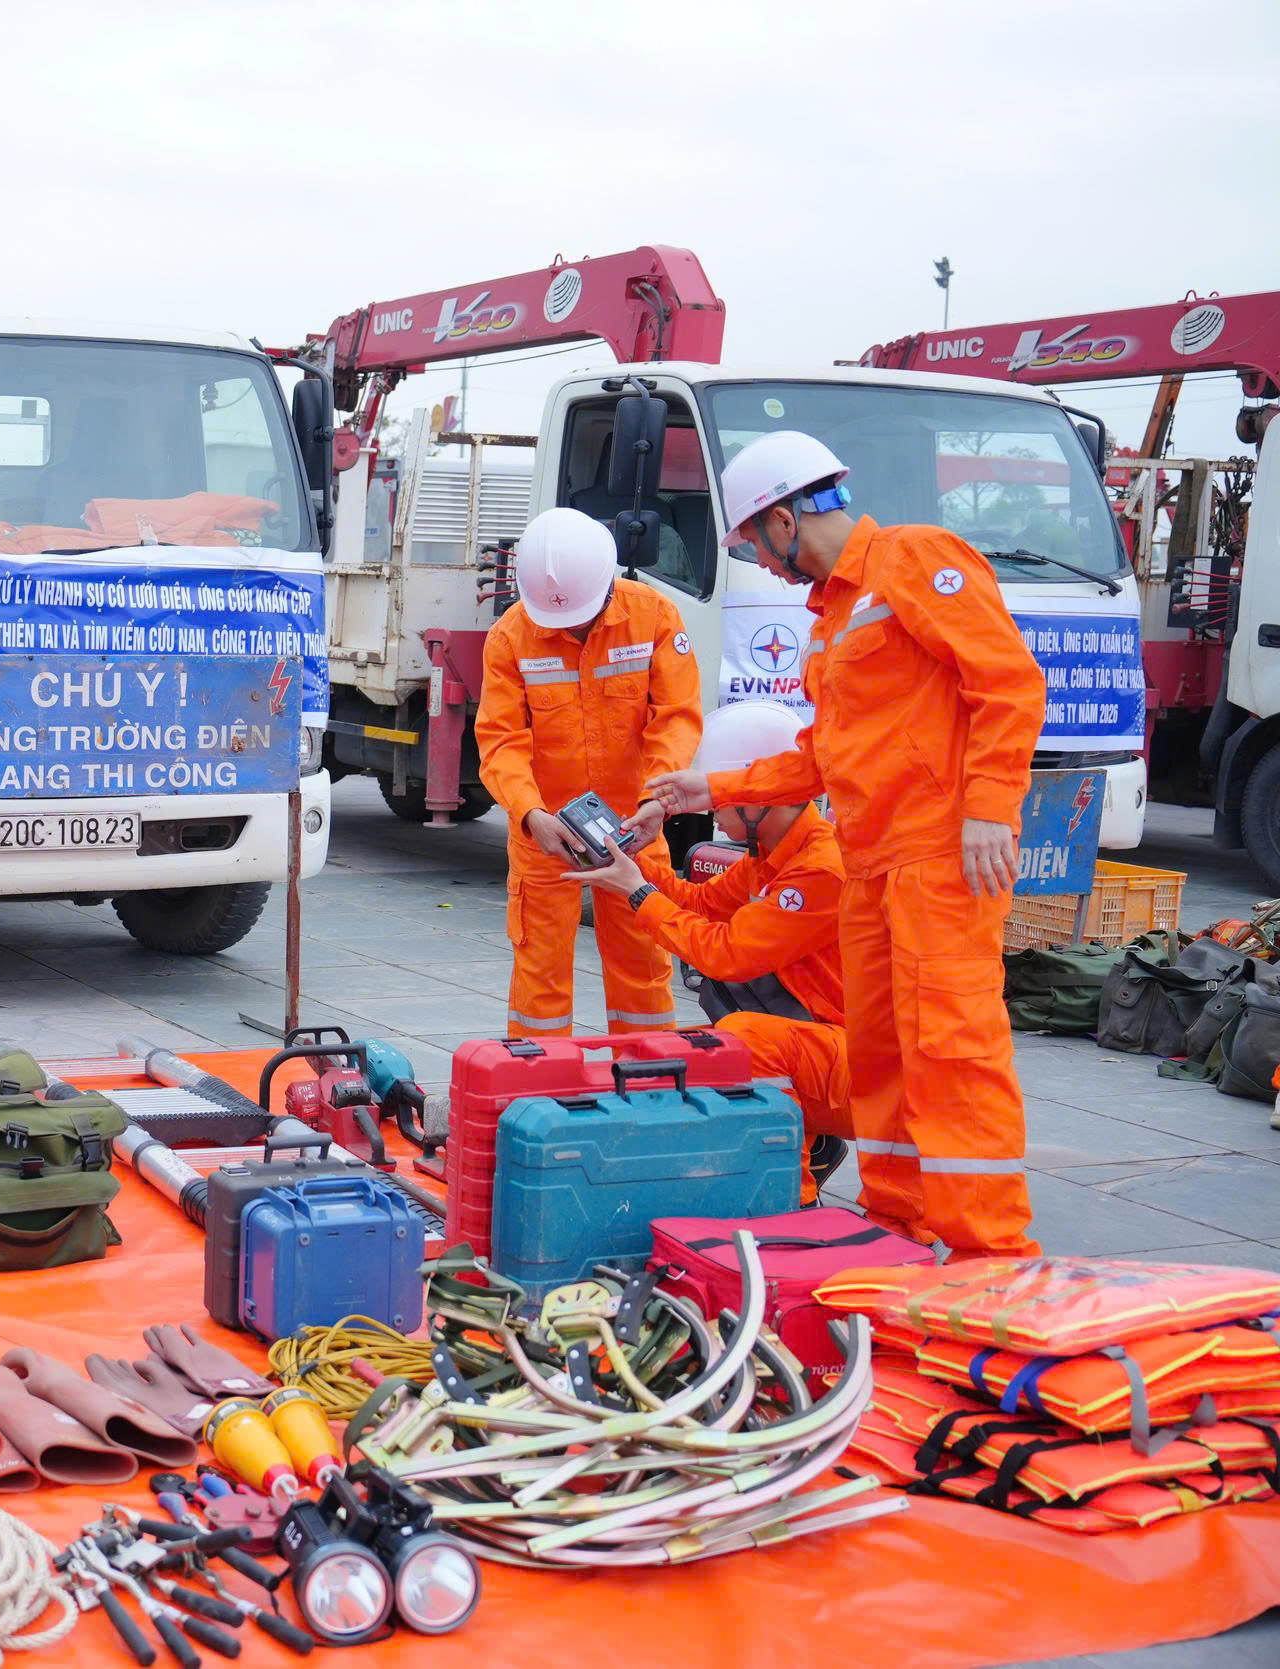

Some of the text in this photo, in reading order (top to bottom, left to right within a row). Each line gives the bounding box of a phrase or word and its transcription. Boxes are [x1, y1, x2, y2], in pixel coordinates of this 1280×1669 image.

[373, 308, 413, 336] UNIC
[926, 336, 984, 361] UNIC
[15, 575, 32, 605] LÝ
[35, 580, 83, 607] NHANH
[86, 581, 105, 613] SỰ
[107, 575, 126, 608] CỐ
[129, 580, 158, 609] LƯỚI
[161, 581, 196, 616] ĐIỆN,
[198, 582, 225, 612] ỨNG
[227, 584, 253, 613] CỨU
[256, 581, 288, 614] KHẨN
[39, 623, 59, 649] TAI
[62, 619, 80, 650] VÀ
[84, 620, 108, 651] TÌM
[112, 619, 145, 651] KIẾM
[149, 622, 175, 652] CỨU
[212, 624, 246, 655] CÔNG
[249, 625, 272, 656] TÁC
[275, 623, 301, 656] VIỄN
[304, 627, 326, 657] THÔN
[1038, 626, 1061, 657] ĐIỆN,
[1063, 627, 1081, 653] ỨNG
[1083, 627, 1099, 654] CỨU
[1100, 625, 1120, 654] KHẨN
[30, 662, 189, 708] CHÚ Ý !
[730, 677, 801, 694] EVNNP
[1048, 667, 1068, 693] NẠN,
[1070, 664, 1094, 689] CÔNG
[1095, 664, 1111, 689] TÁC
[1112, 661, 1128, 689] VIỄN
[1045, 698, 1118, 724] ÔNG TY NĂM 2026
[48, 719, 187, 752] TRƯỜNG
[82, 763, 133, 788] THI
[145, 756, 237, 789] CÔNG
[1018, 840, 1070, 885] ĐIỆN
